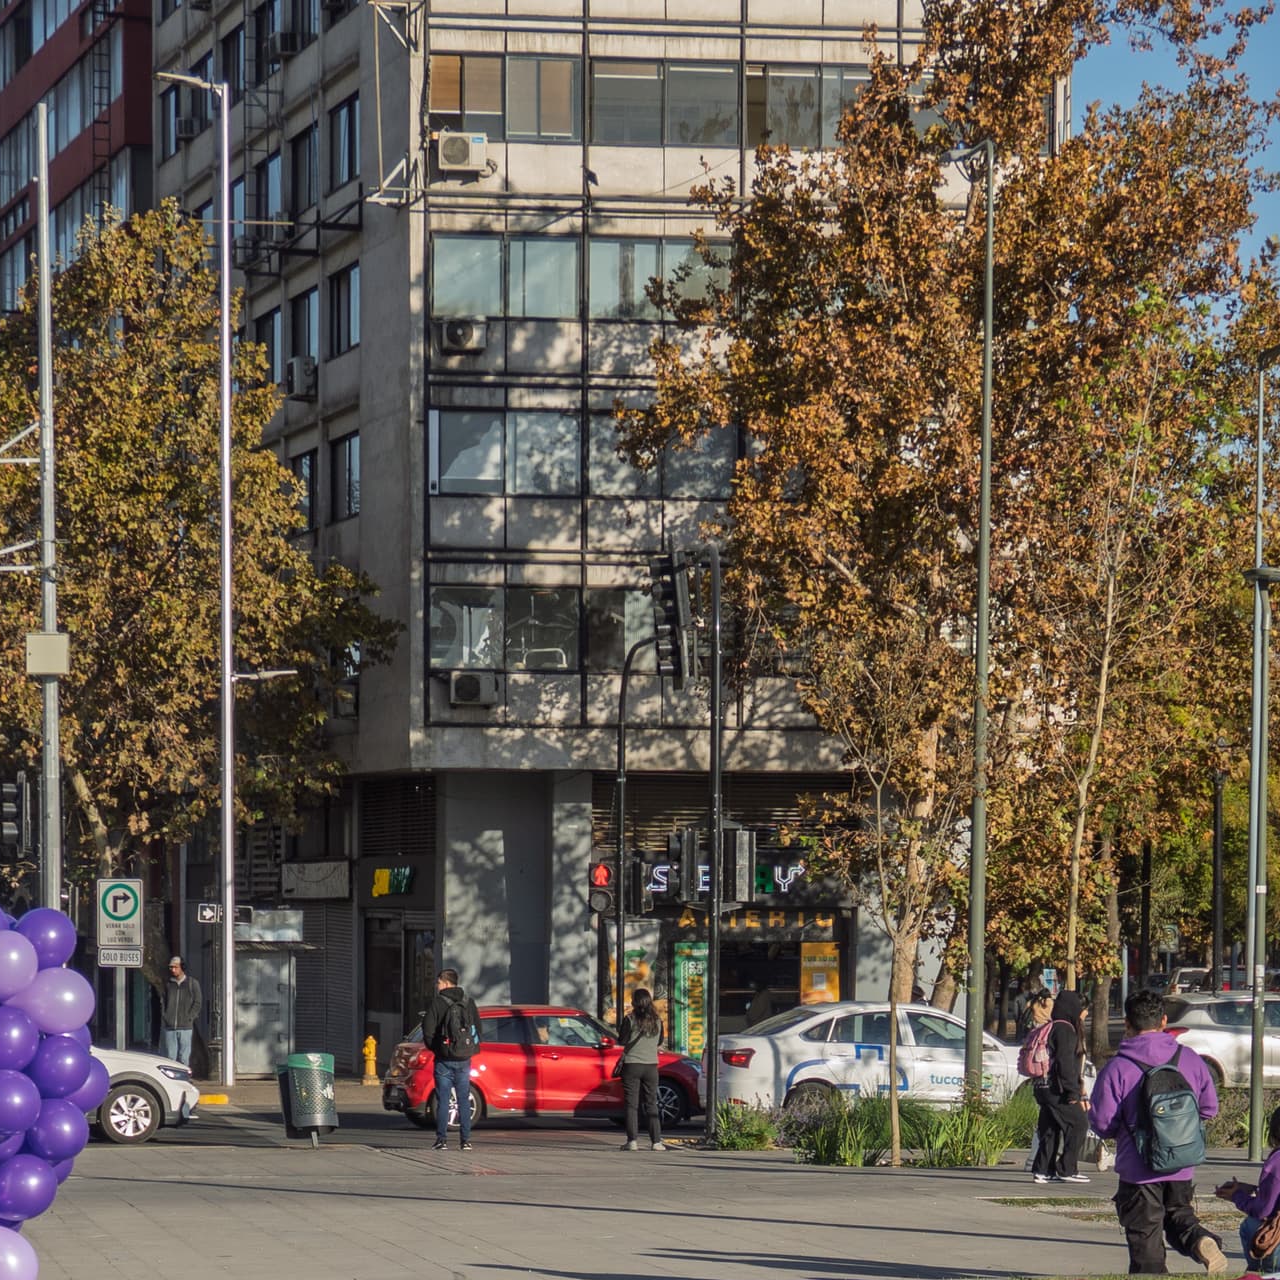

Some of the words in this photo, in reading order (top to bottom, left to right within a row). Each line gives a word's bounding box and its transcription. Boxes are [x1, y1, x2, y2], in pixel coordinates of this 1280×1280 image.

[102, 952, 118, 961] SOLO
[119, 952, 139, 962] BUSES
[687, 975, 704, 1055] FOOTLONG
